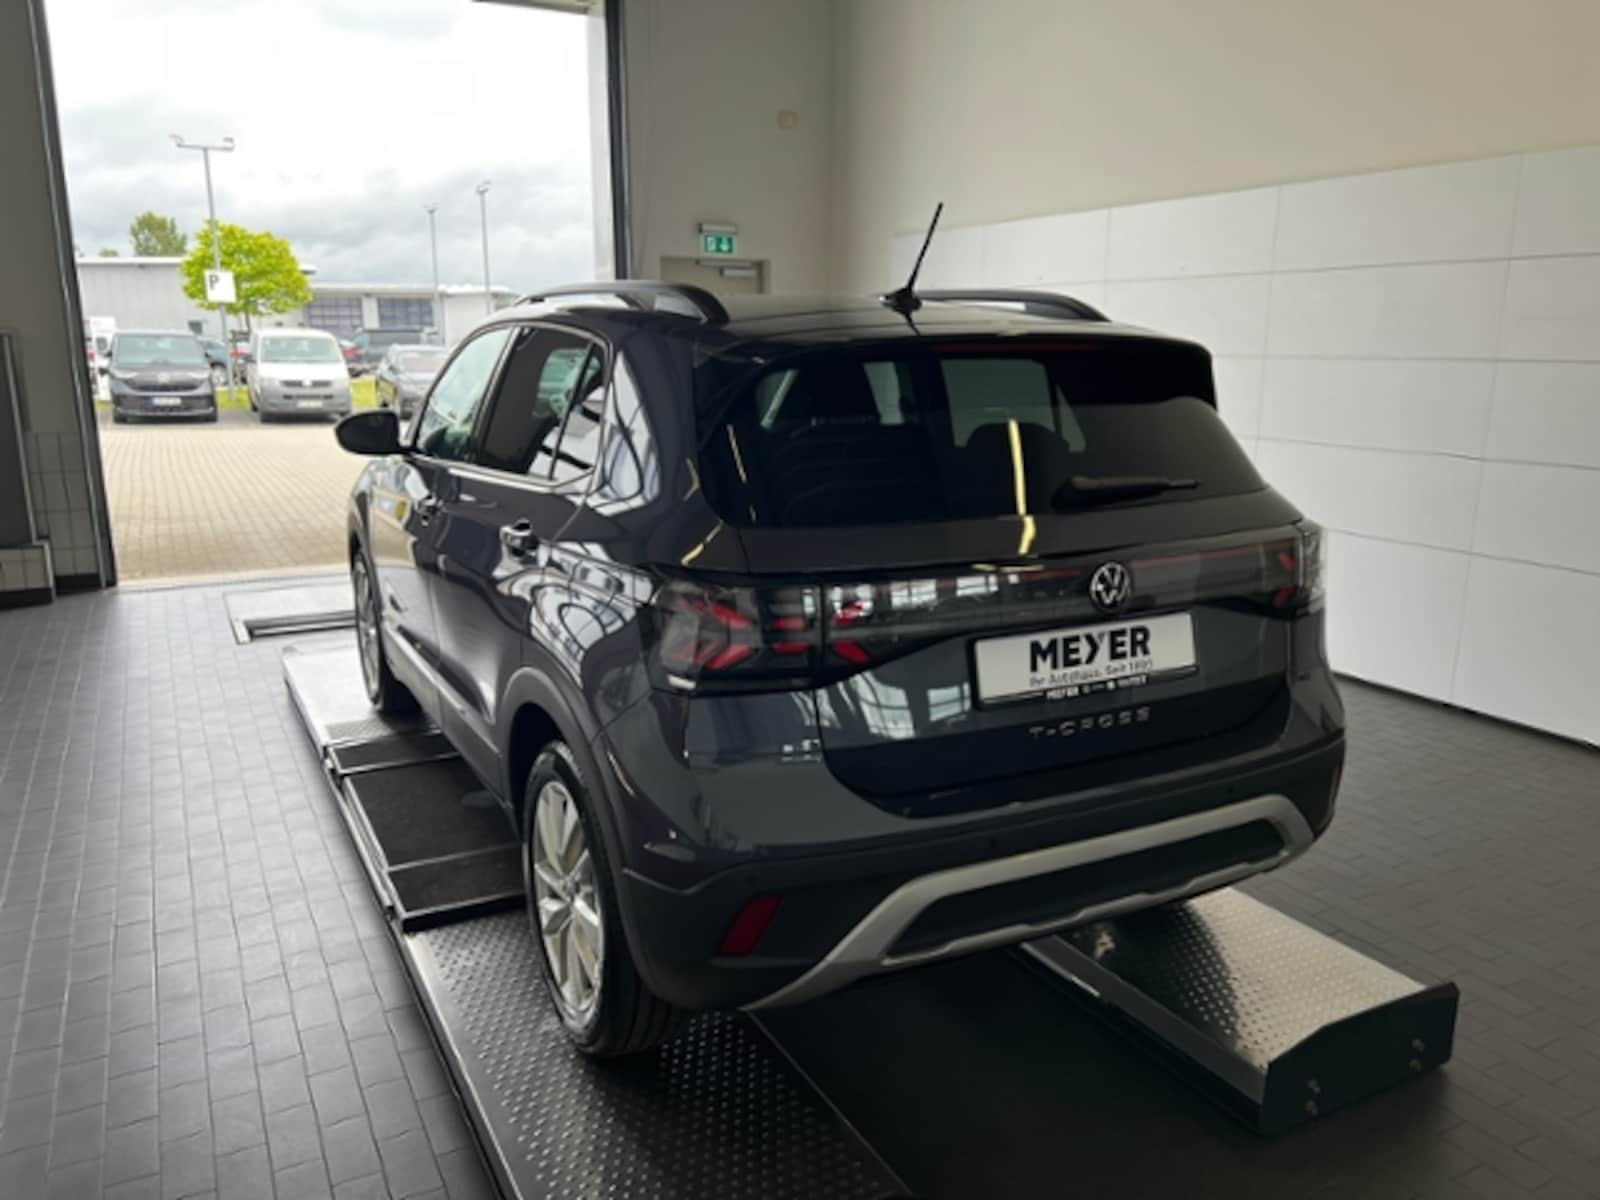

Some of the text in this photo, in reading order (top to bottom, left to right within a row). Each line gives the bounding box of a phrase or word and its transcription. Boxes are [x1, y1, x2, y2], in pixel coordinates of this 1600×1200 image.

[209, 274, 220, 290] P
[1030, 626, 1151, 672] MEYER
[1029, 706, 1151, 739] T-CROSS
